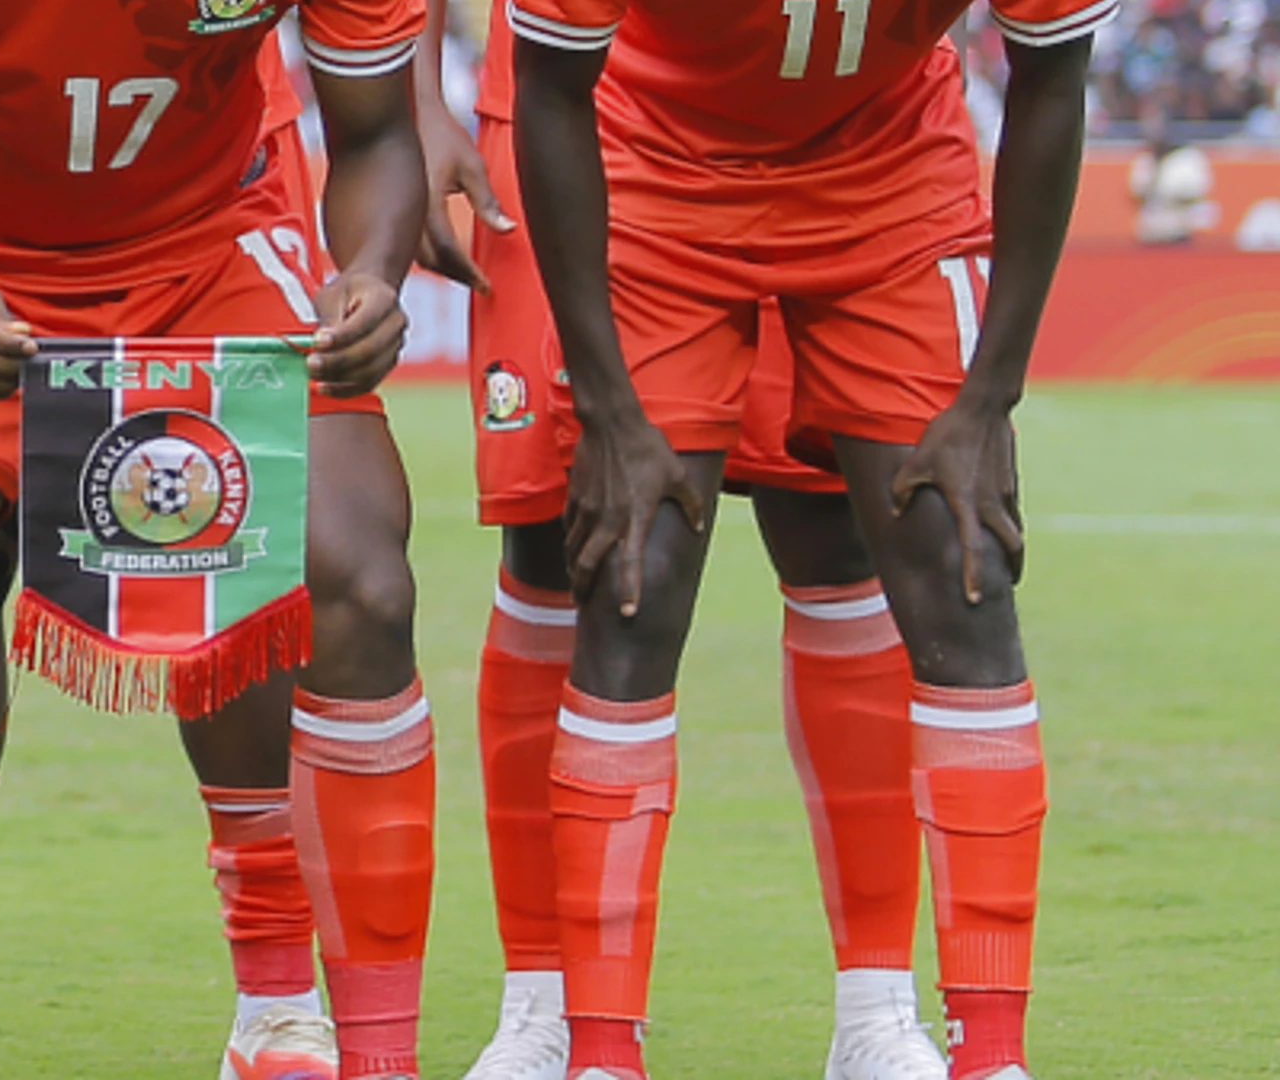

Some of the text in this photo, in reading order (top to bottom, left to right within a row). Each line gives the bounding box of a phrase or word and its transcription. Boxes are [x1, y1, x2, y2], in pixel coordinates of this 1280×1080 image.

[65, 77, 179, 171] 17
[938, 255, 990, 372] 1
[49, 359, 284, 390] KENYA
[90, 435, 135, 538] FOOTBALL
[216, 449, 245, 526] KENYA
[100, 551, 229, 570] FEDERATION
